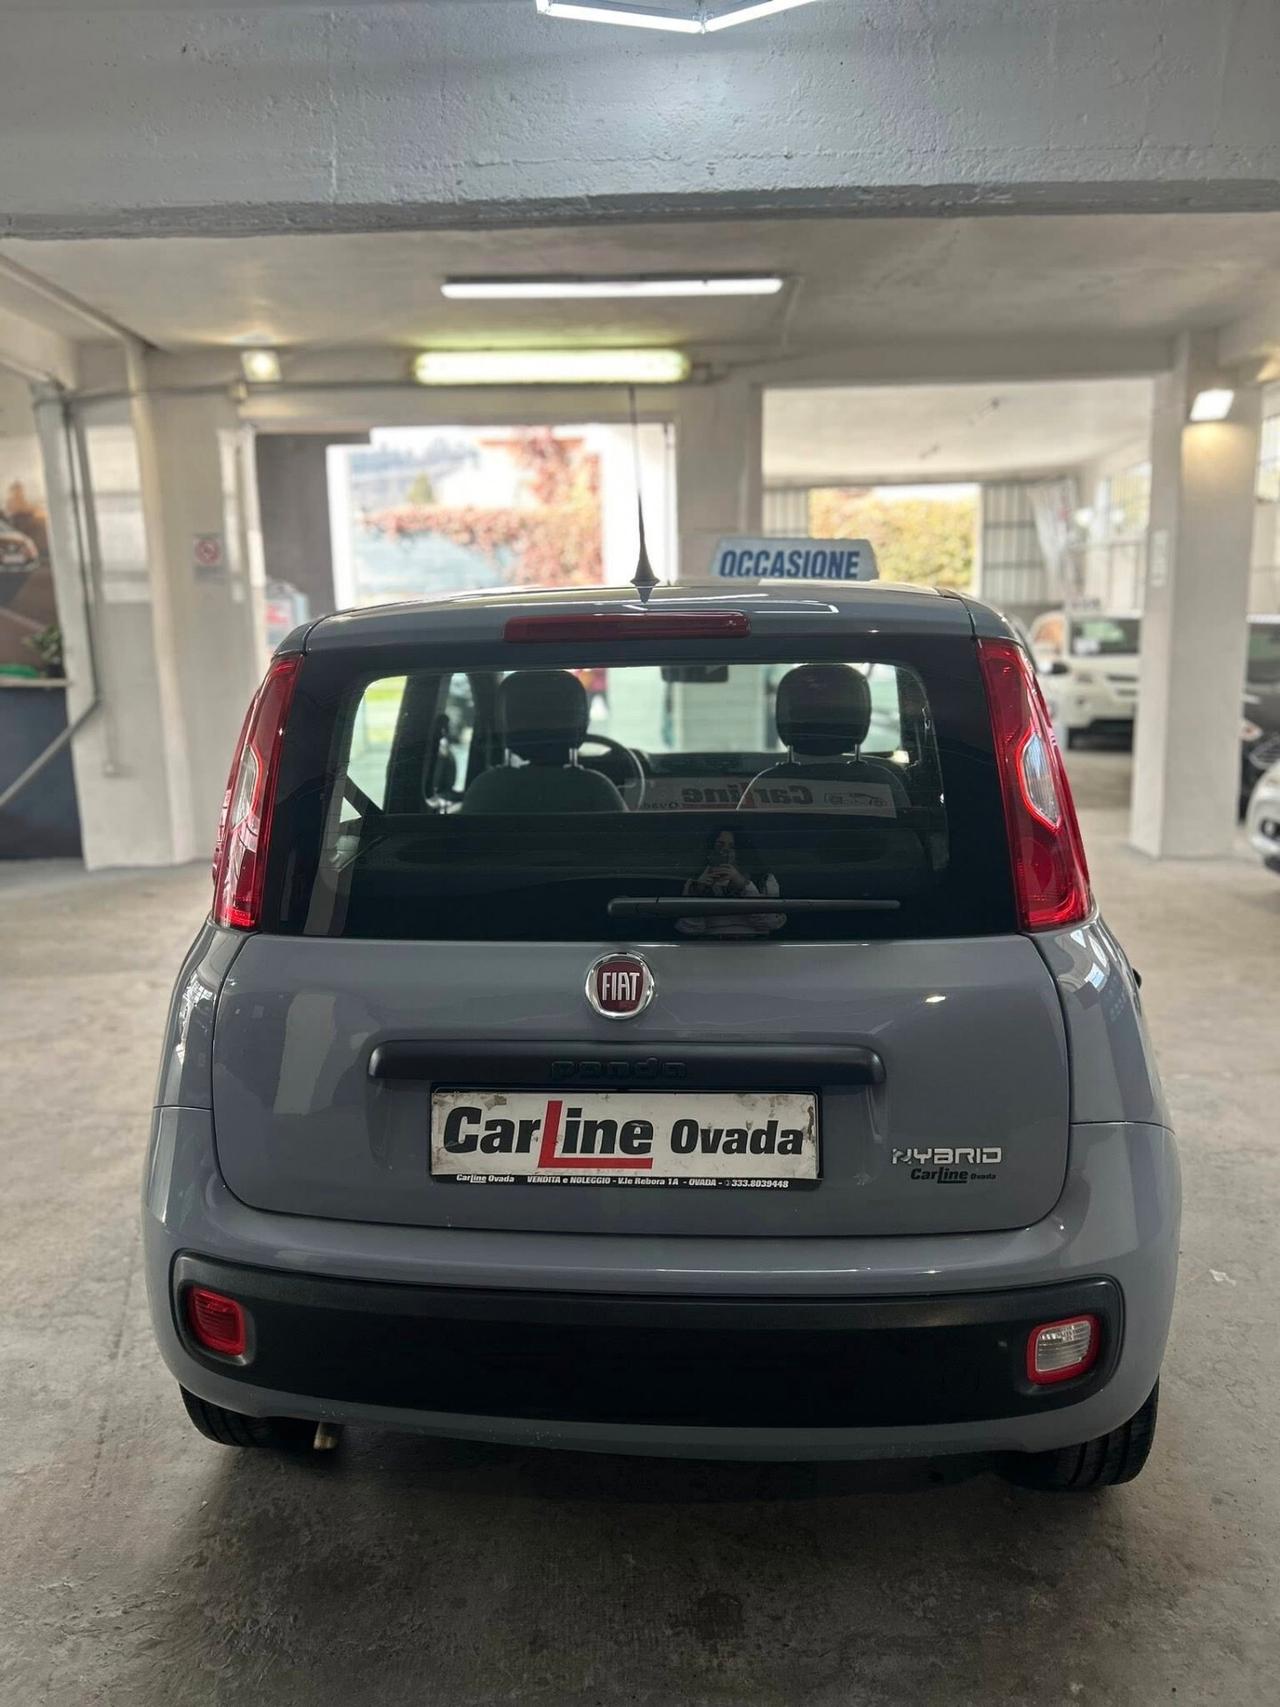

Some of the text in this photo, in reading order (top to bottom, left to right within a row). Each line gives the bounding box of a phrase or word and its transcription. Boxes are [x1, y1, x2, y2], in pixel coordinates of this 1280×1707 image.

[719, 551, 861, 578] OCCASIONE
[602, 972, 640, 1000] FIAT
[670, 1118, 804, 1155] Ovada
[488, 1175, 515, 1183] Ovada
[527, 1175, 561, 1184] VENDITA
[570, 1176, 611, 1185] NOLEGGIO
[634, 1177, 666, 1185] Rebora
